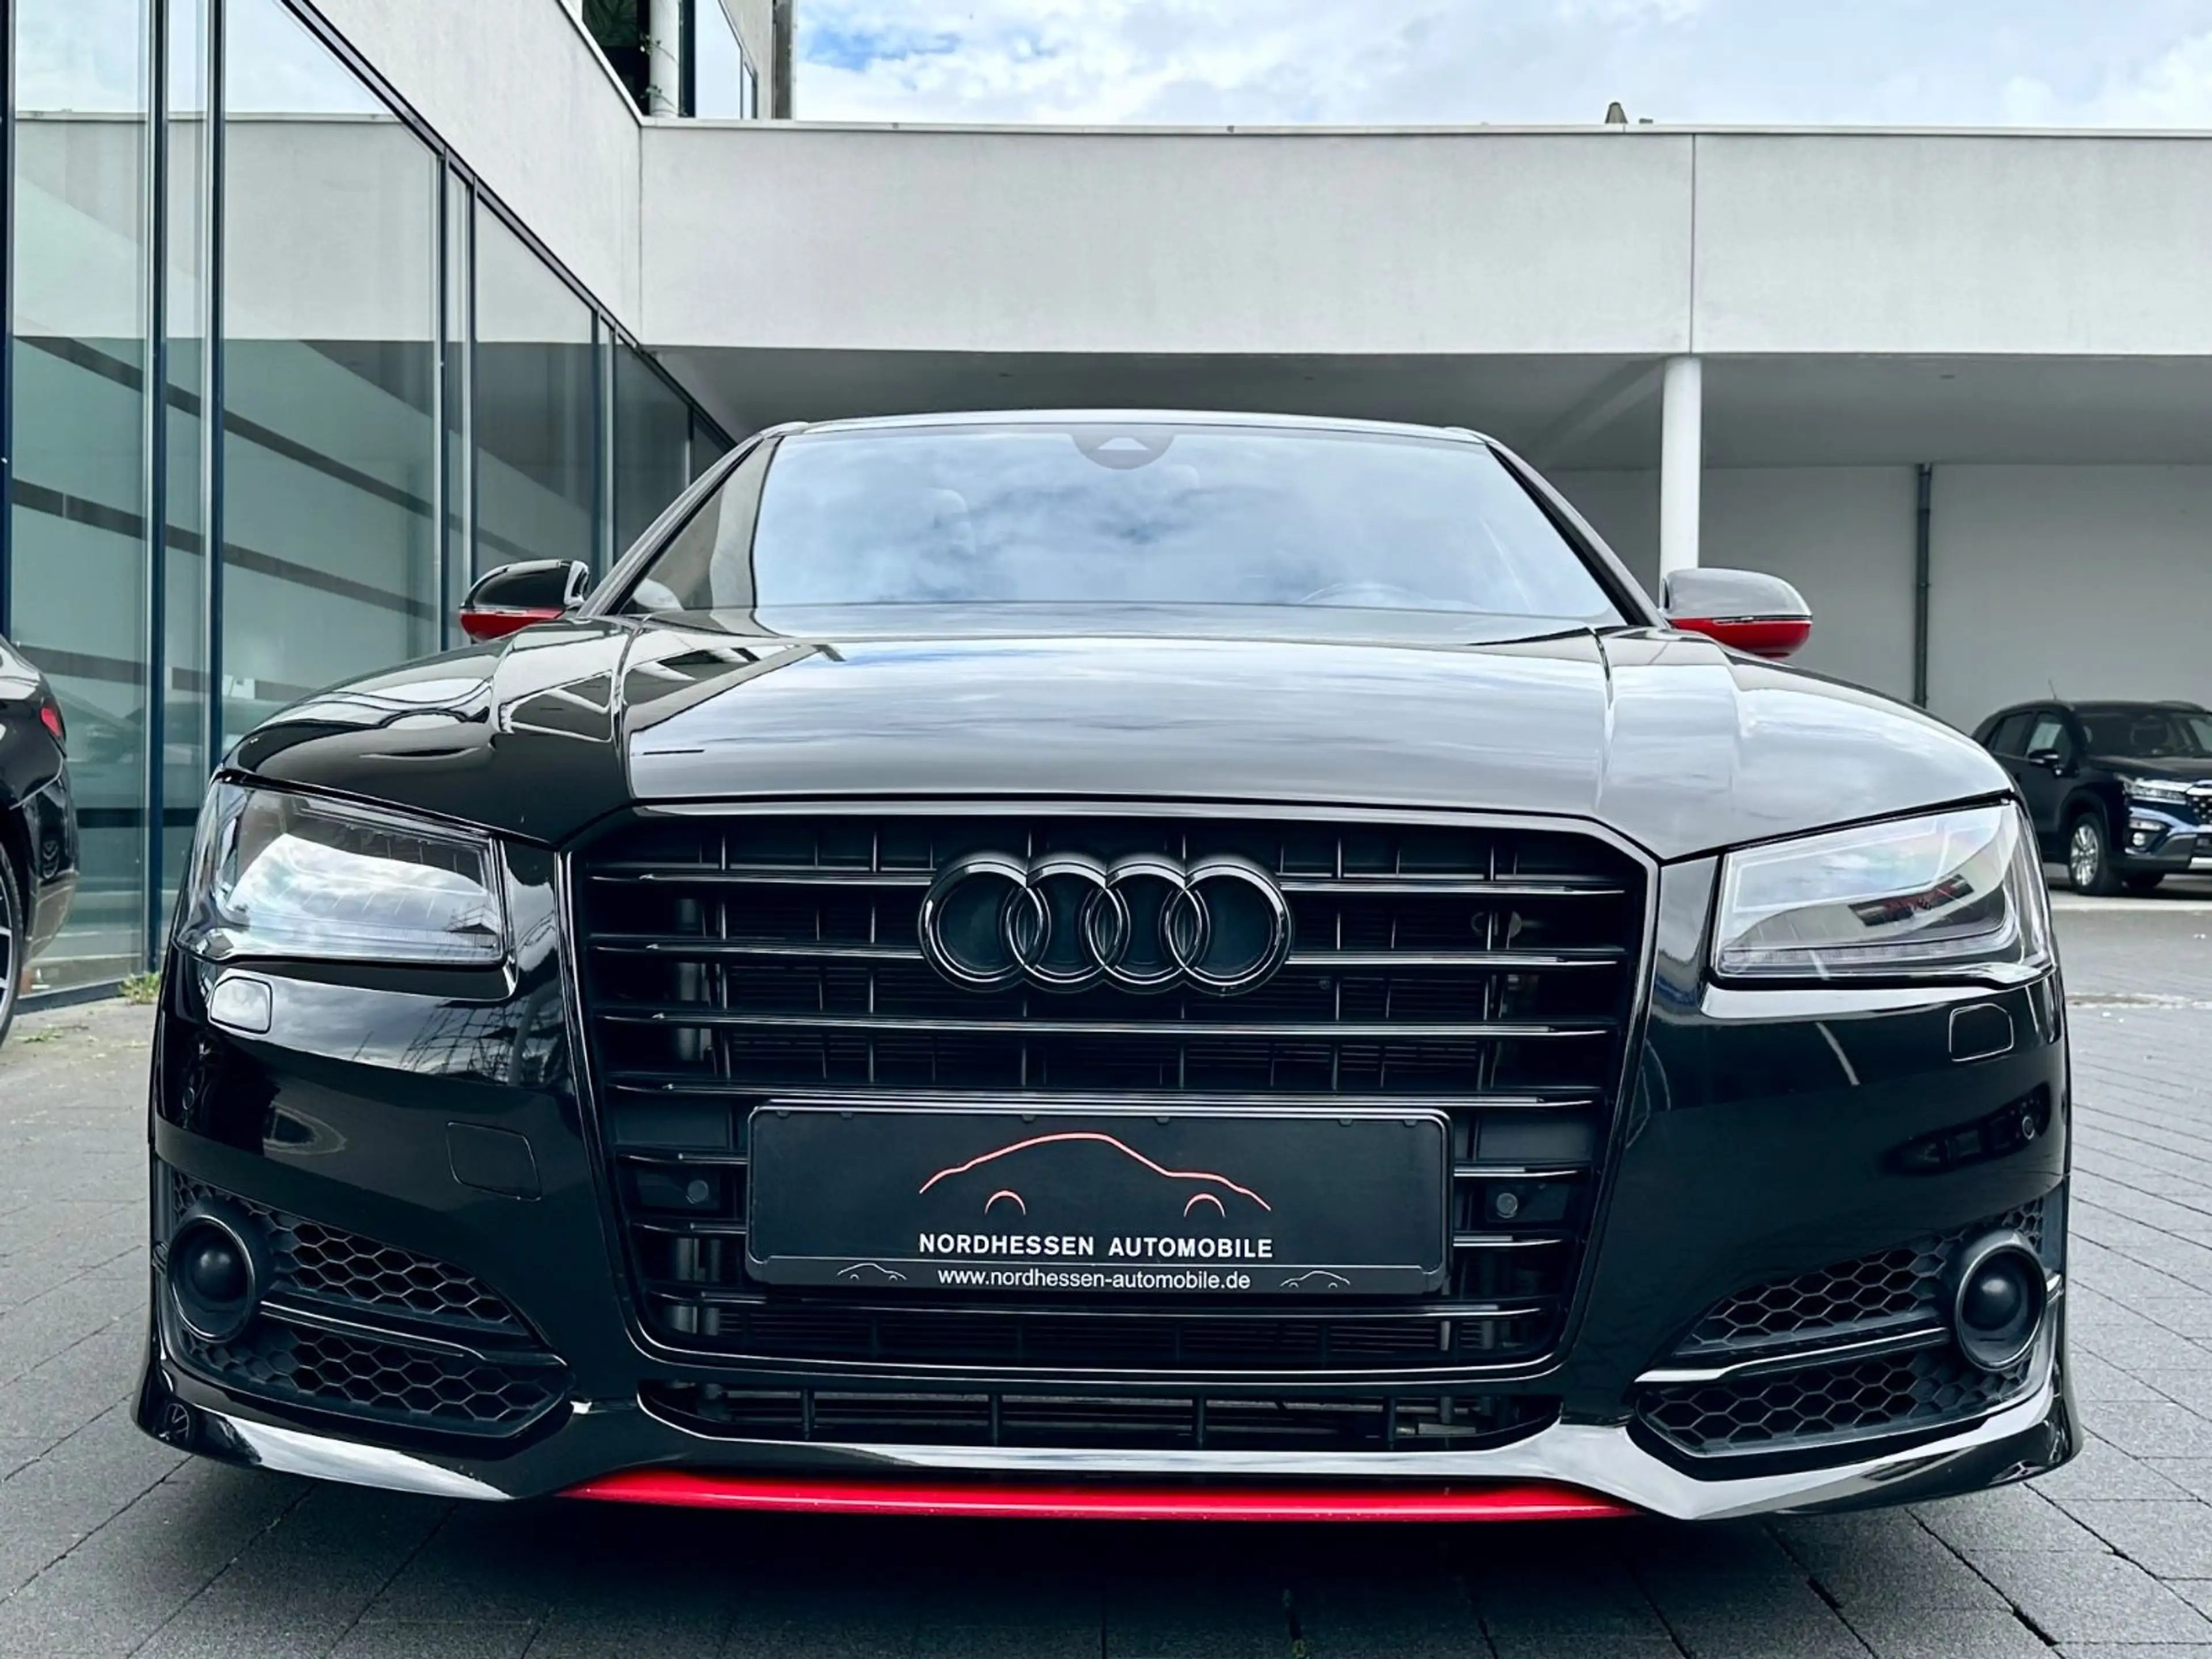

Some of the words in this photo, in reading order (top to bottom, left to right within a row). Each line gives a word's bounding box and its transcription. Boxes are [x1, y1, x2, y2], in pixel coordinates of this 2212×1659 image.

[919, 1233, 1094, 1256] NORDHESSEN
[1108, 1236, 1273, 1258] AUTOMOBILE
[937, 1267, 1251, 1290] www.nordhessen-automobile.de
